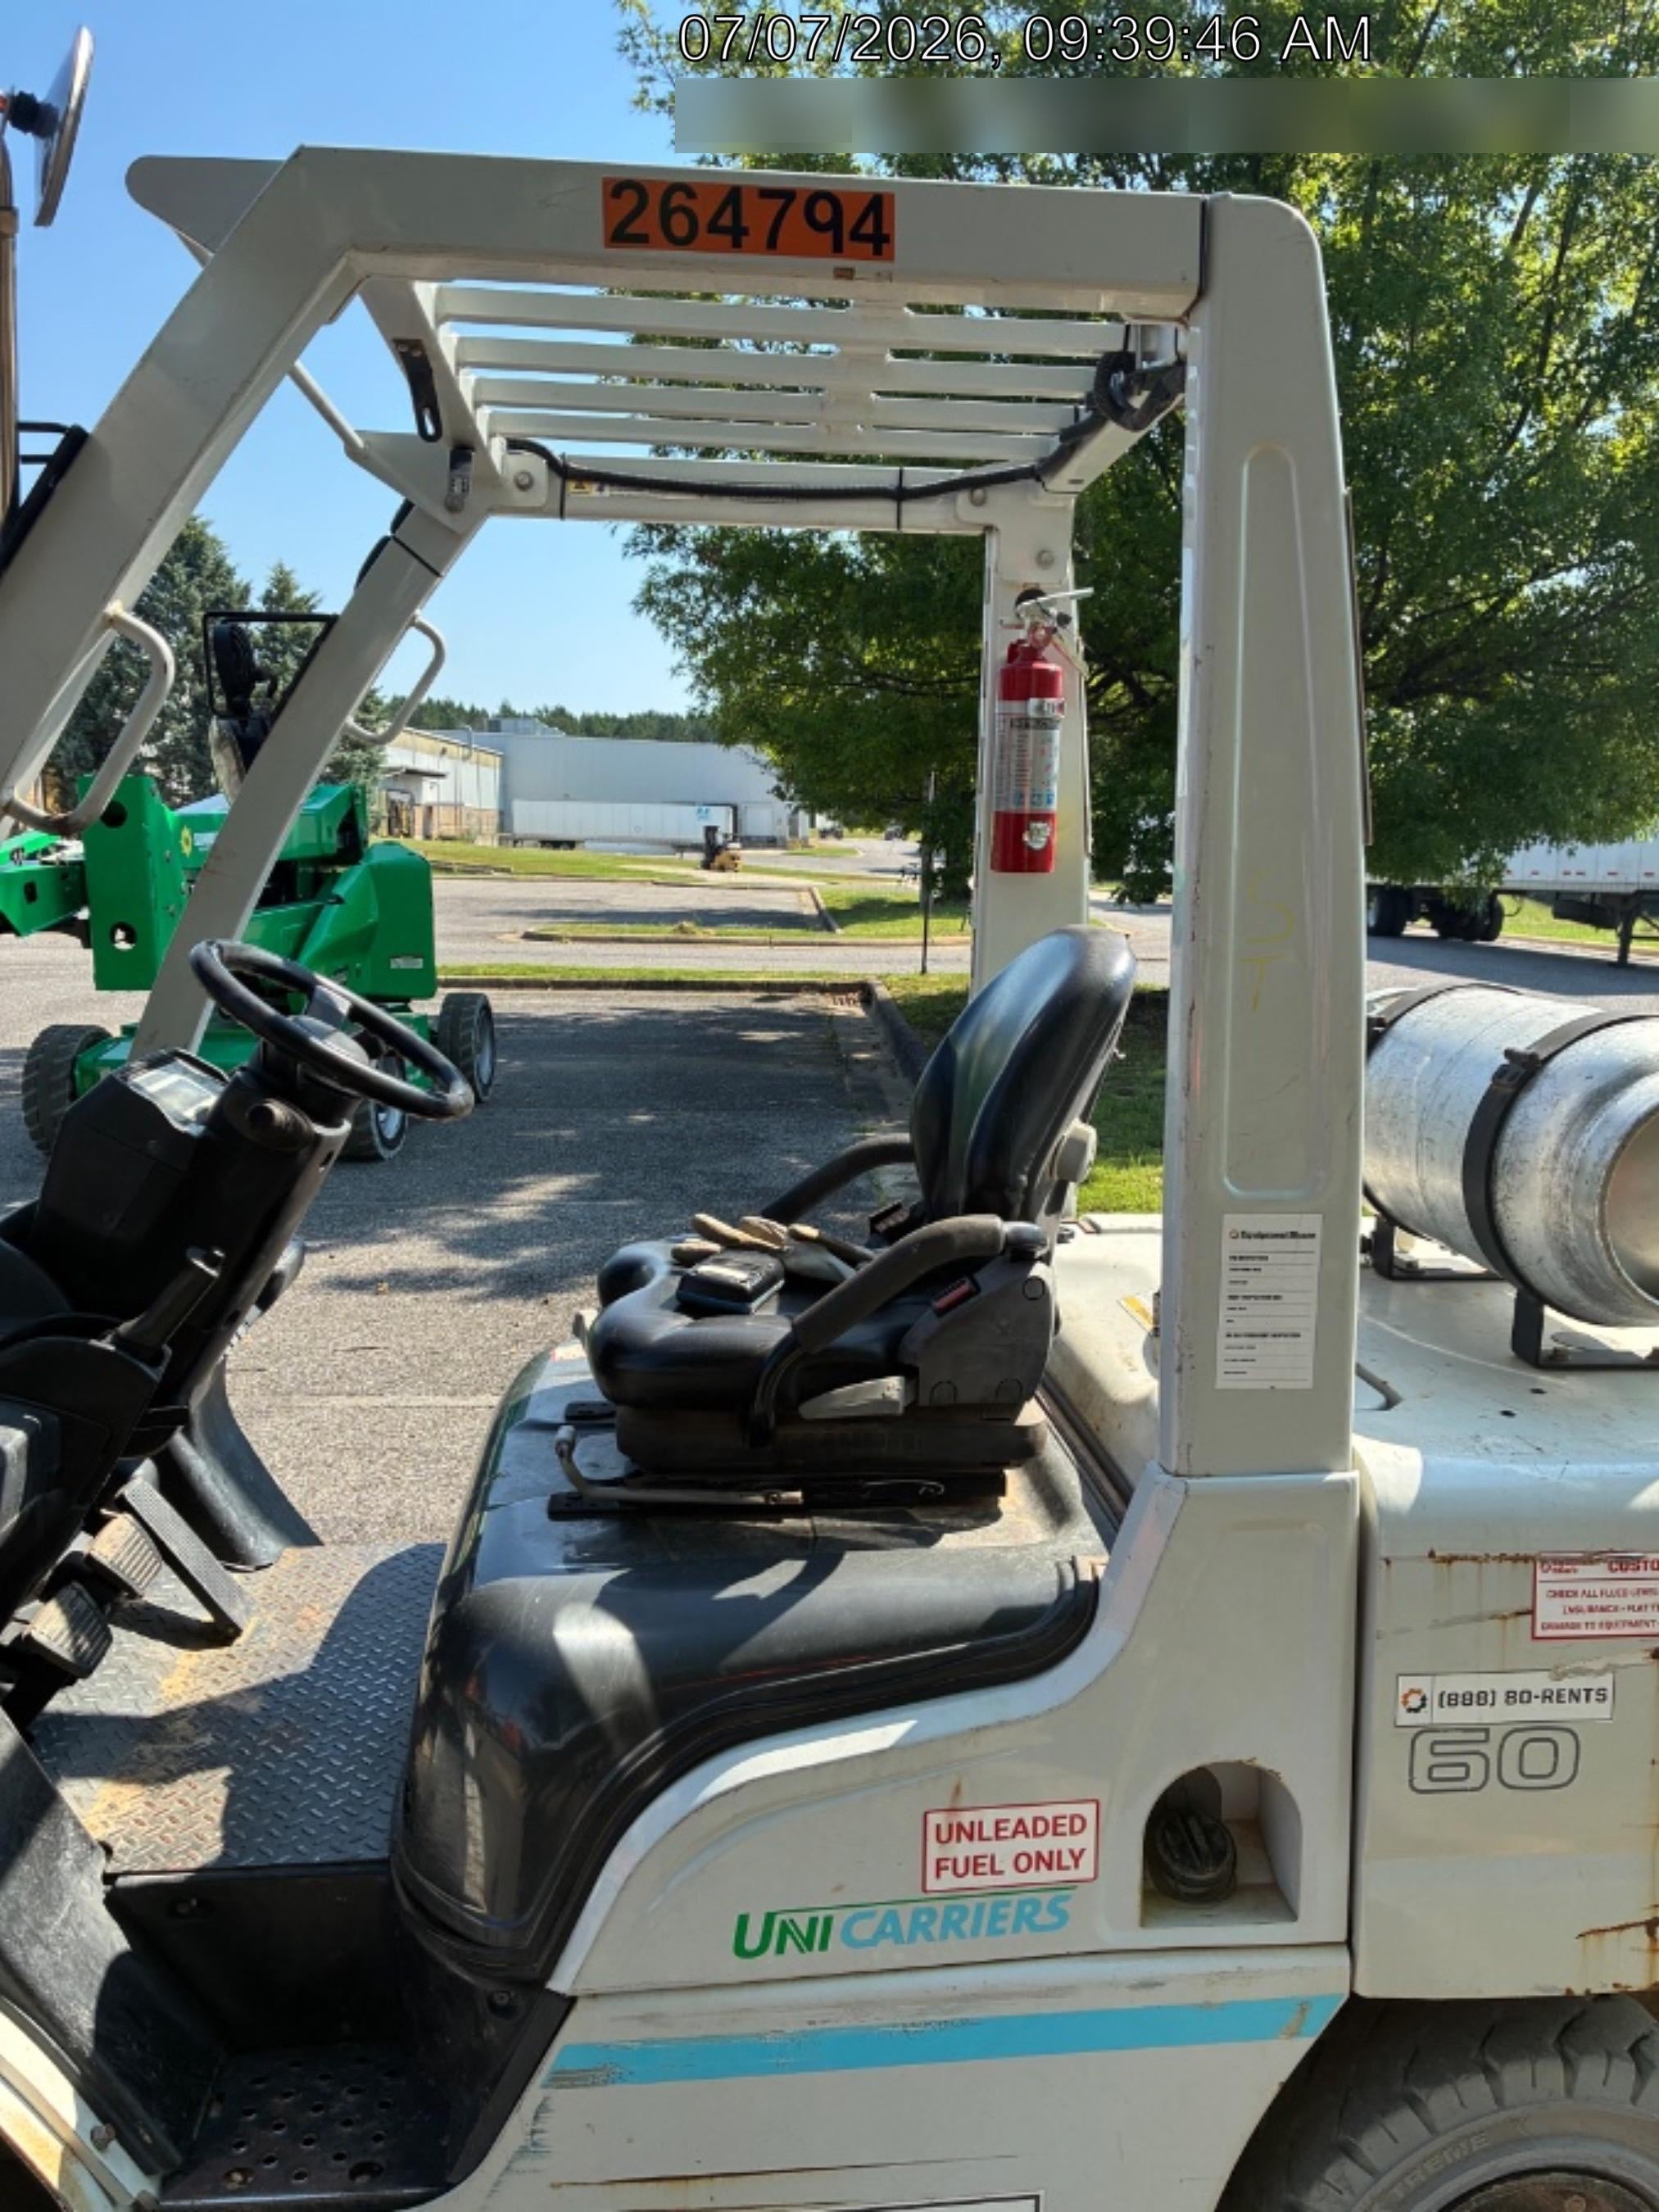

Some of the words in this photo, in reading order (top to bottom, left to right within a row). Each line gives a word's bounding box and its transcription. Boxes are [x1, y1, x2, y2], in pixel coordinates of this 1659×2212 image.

[610, 179, 891, 256] 264794
[1408, 1725, 1581, 1794] 60
[935, 1813, 1088, 1844] UNLEADED
[935, 1853, 1005, 1879] FUEL
[1013, 1847, 1087, 1874] ONLY
